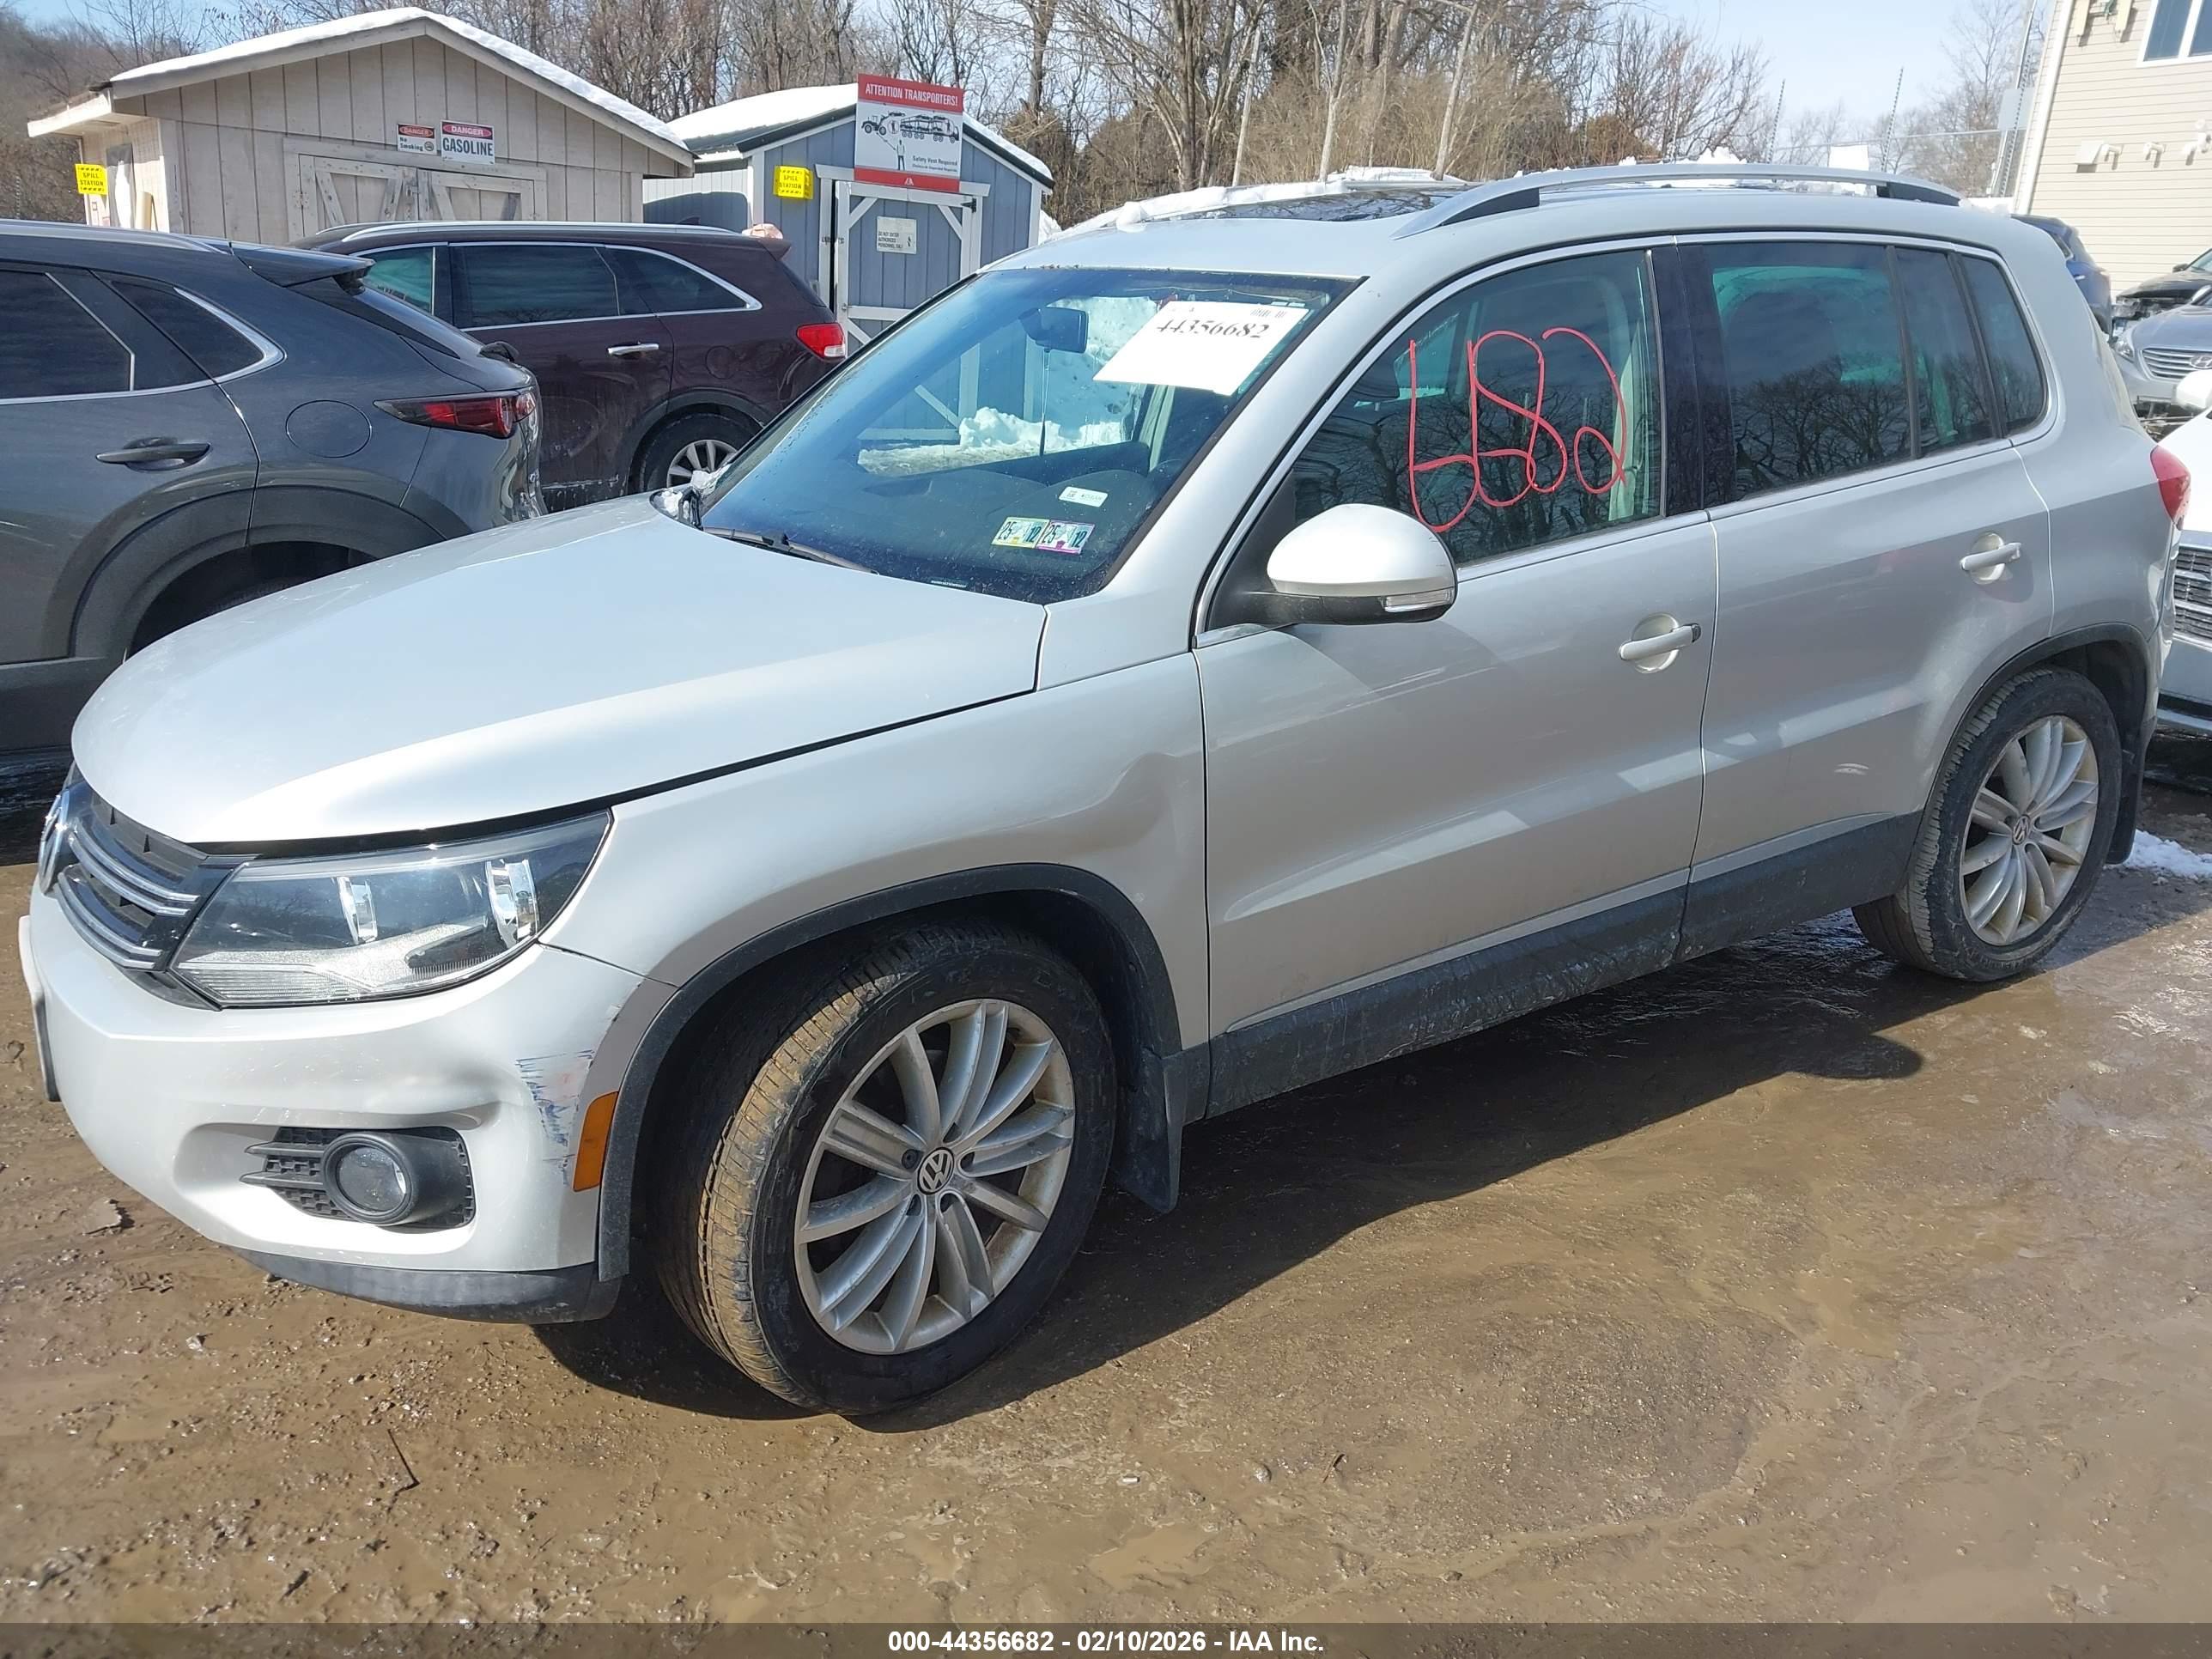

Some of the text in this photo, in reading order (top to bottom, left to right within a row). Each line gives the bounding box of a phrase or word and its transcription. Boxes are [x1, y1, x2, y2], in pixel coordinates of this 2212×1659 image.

[866, 83, 958, 106] ATTENTION TRANSPORTERS!
[451, 125, 483, 137] DANGER
[399, 143, 423, 151] Smoking
[442, 137, 493, 156] GASOLINE
[1157, 319, 1270, 338] 44356682
[997, 520, 1042, 544] 25 12
[1041, 524, 1088, 548] 25 12
